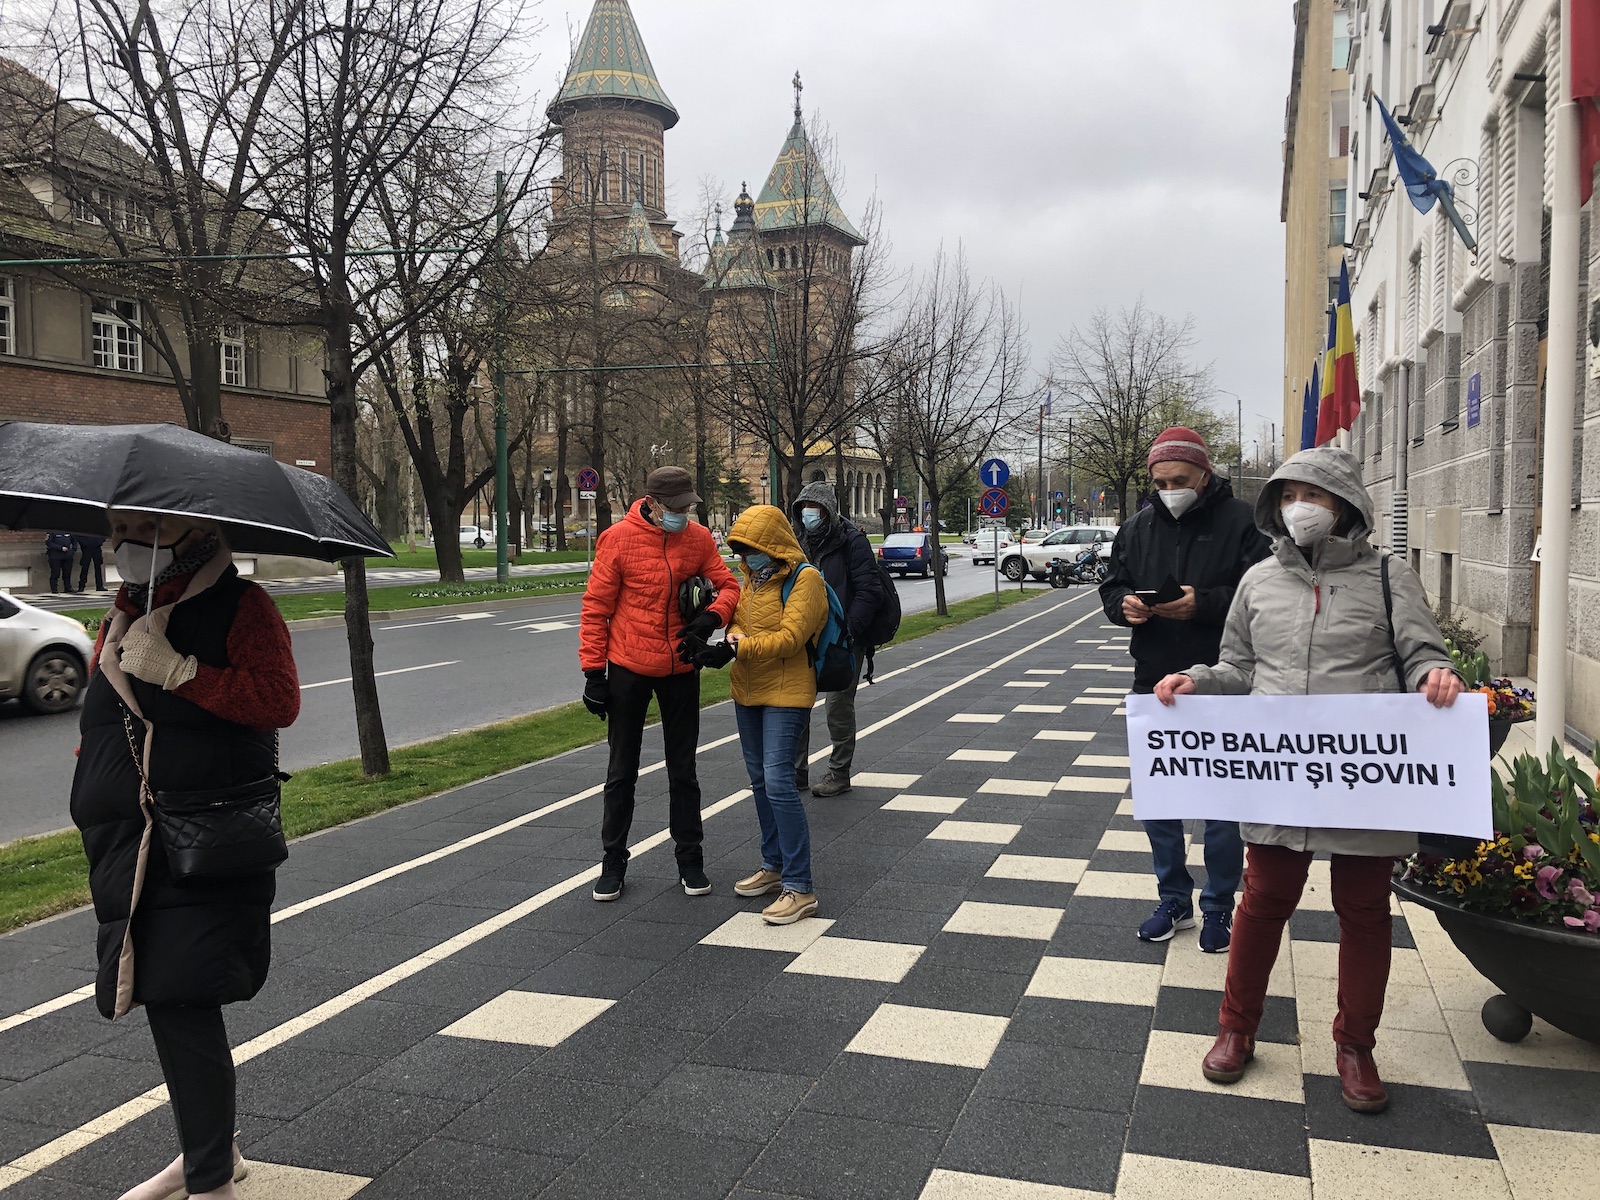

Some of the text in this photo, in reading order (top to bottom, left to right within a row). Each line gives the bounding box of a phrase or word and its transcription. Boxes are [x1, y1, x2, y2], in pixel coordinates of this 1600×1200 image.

[1147, 730, 1408, 755] STOP BALAURULUI
[1149, 757, 1299, 782] ANTISEMIT
